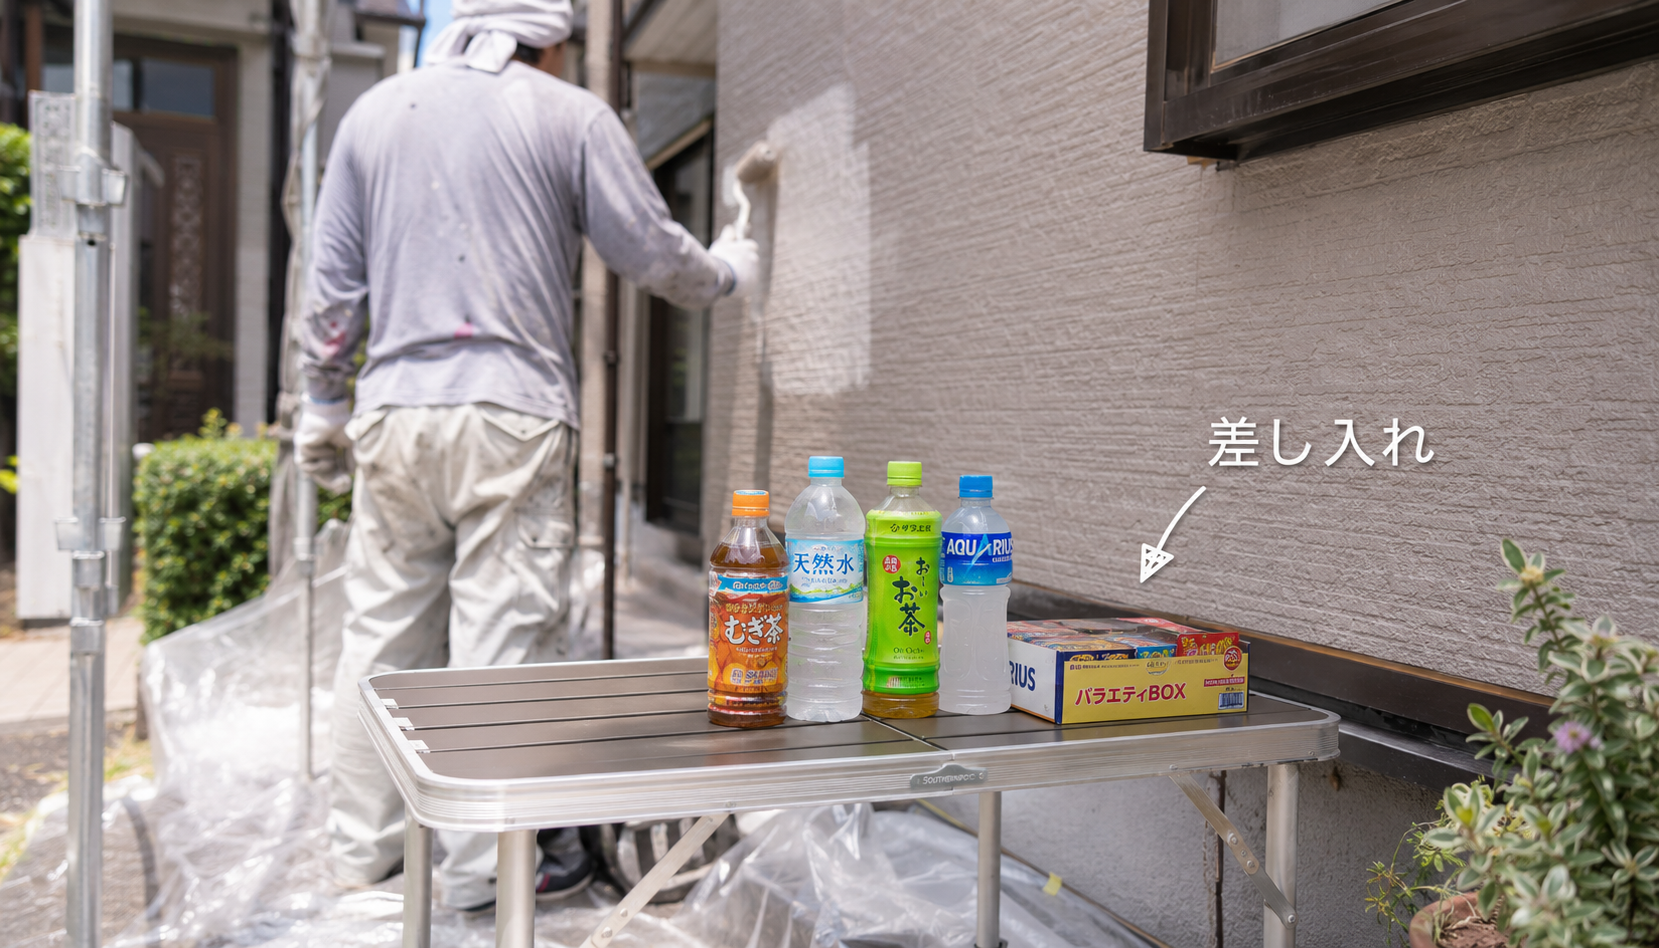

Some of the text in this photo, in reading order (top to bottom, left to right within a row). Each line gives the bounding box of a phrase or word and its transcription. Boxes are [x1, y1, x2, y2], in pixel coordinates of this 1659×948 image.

[793, 552, 854, 575] 天然水
[892, 575, 926, 637] お茶
[724, 612, 784, 645] むぎ茶
